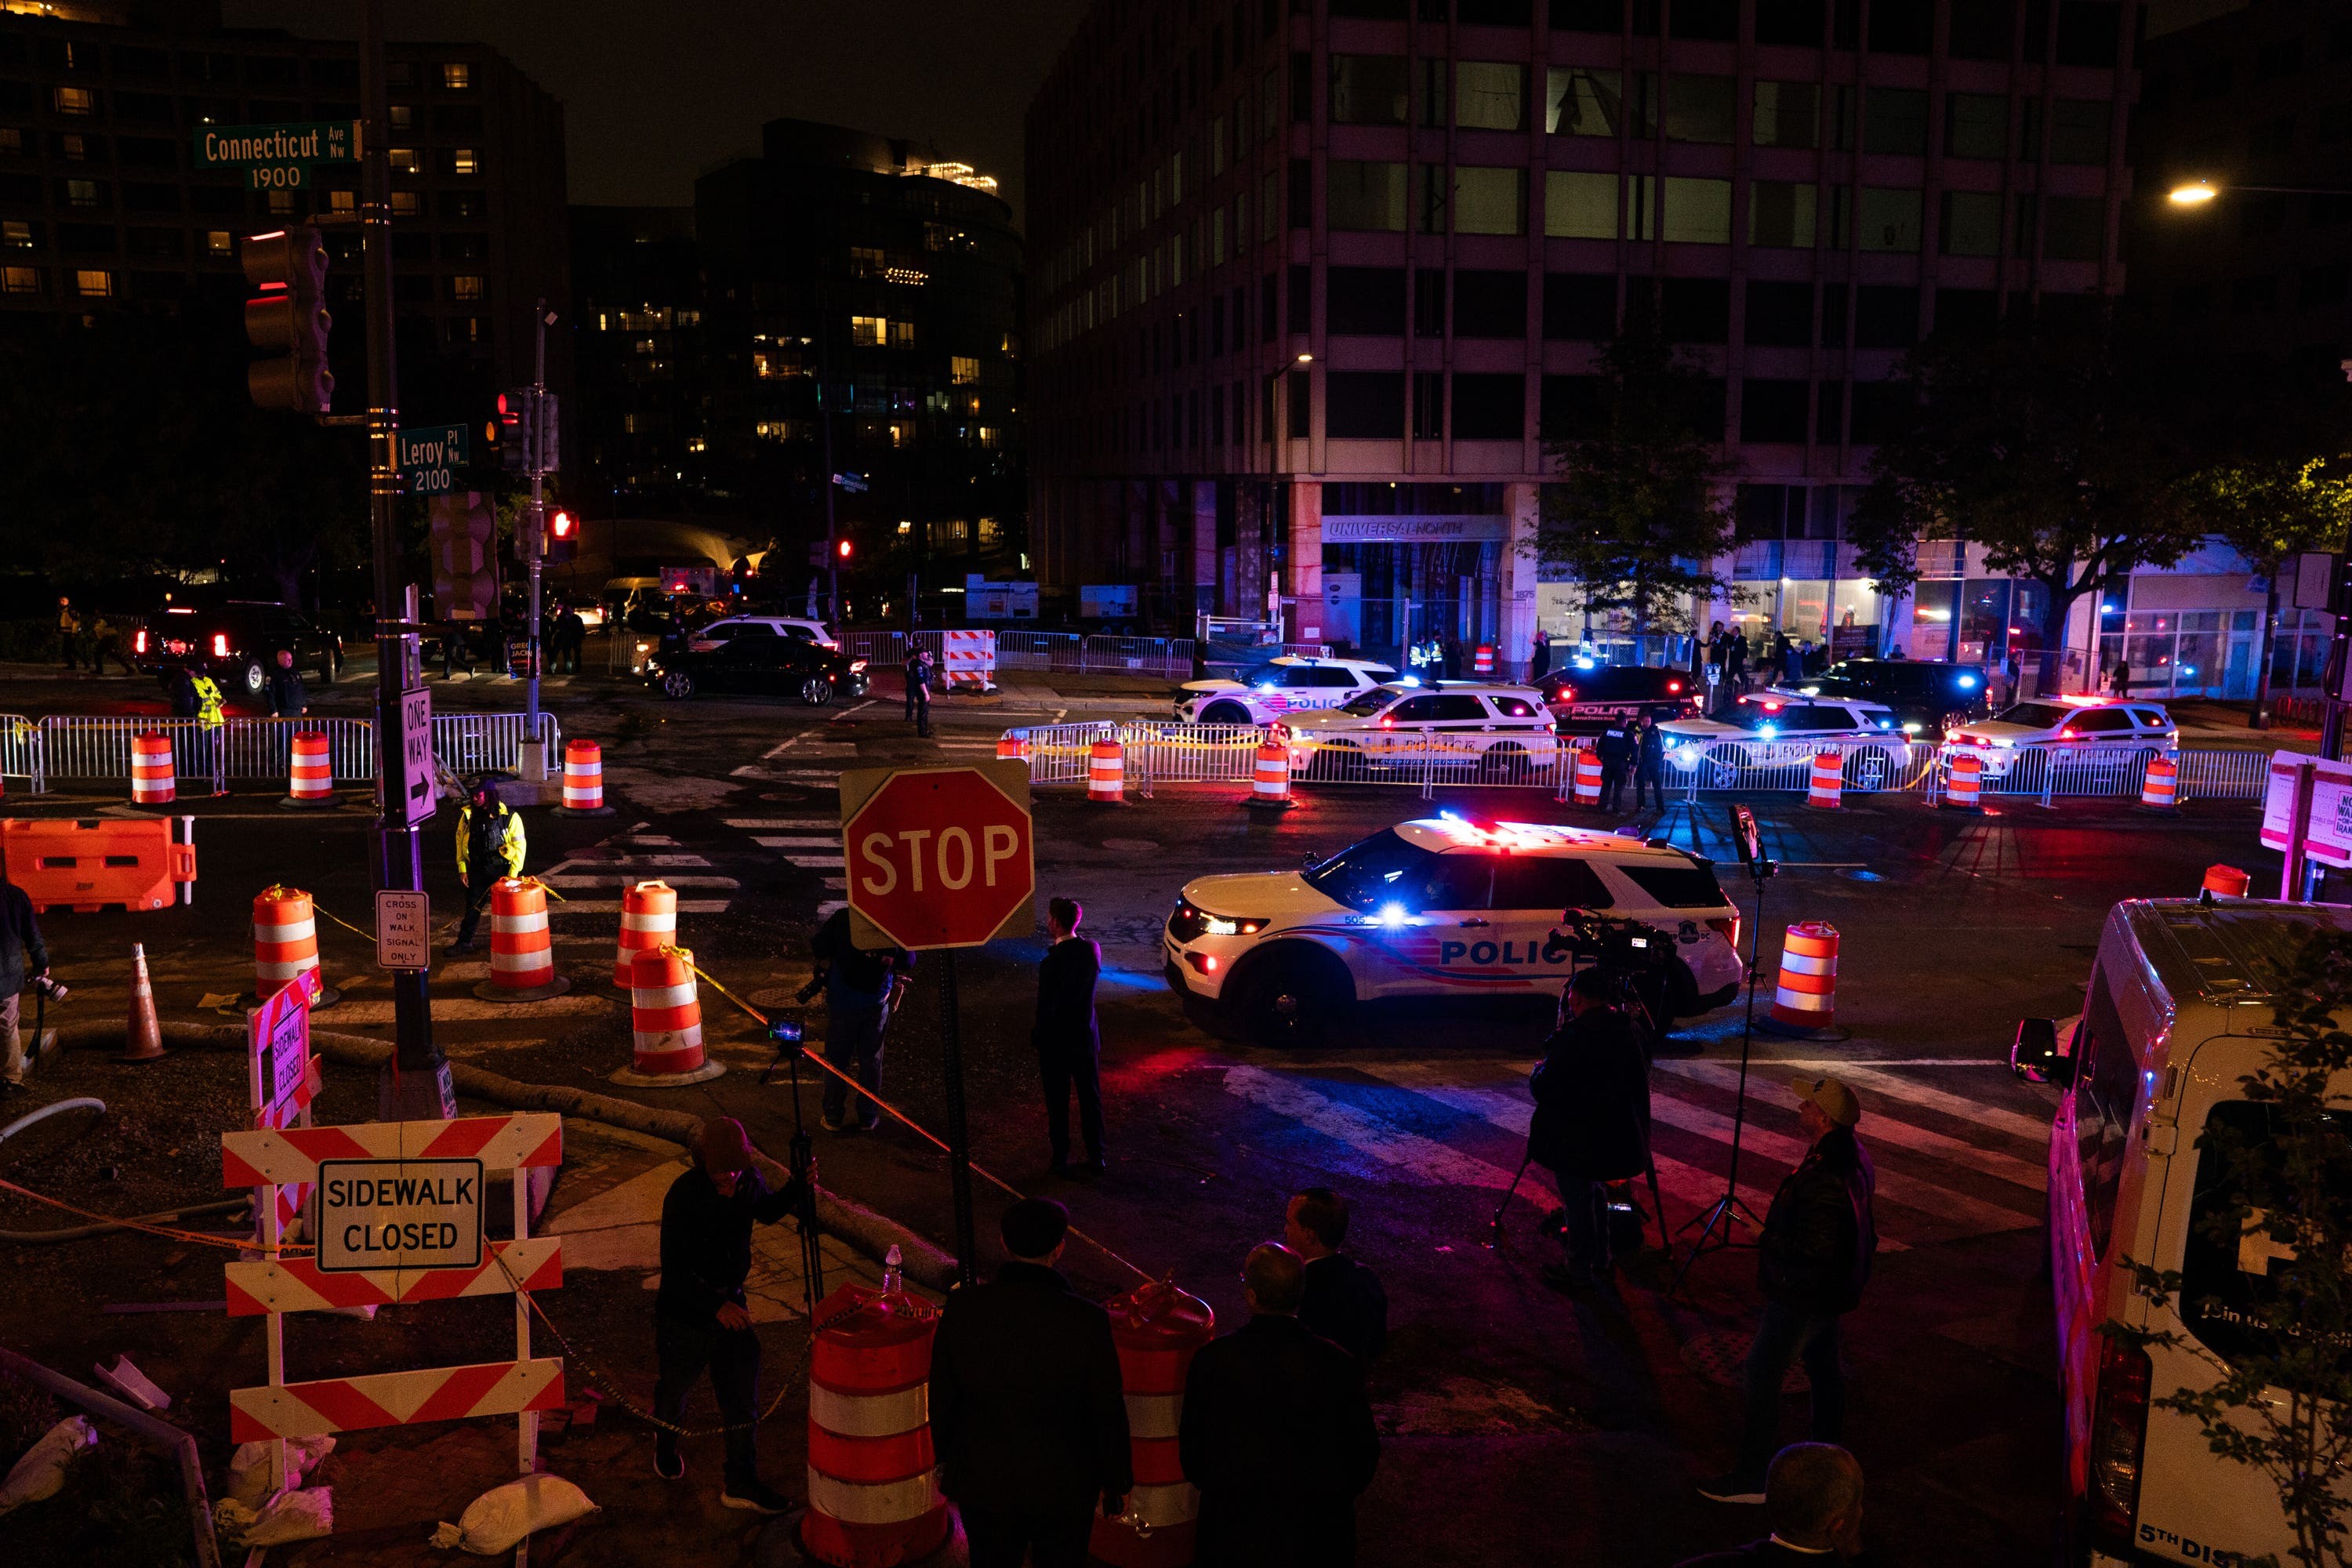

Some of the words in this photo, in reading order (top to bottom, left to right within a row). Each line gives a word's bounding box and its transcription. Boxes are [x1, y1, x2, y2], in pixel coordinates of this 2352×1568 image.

[205, 129, 319, 162] Connecticut
[328, 125, 344, 141] Ave
[329, 143, 345, 158] Nw
[252, 166, 301, 188] 1900
[401, 437, 445, 469] Leroy
[447, 429, 459, 445] Pl
[448, 447, 460, 463] Nw
[415, 469, 451, 492] 2100
[407, 699, 426, 731] ONE
[1287, 699, 1339, 710] POLIC
[408, 733, 428, 767] WAY
[2338, 804, 2352, 818] WA
[862, 824, 1019, 896] STOP
[386, 900, 417, 909] CROSS
[1345, 916, 1366, 924] 505
[390, 953, 416, 961] ONLY
[274, 1019, 303, 1062] SIDEWALK
[278, 1053, 301, 1091] CLOSED
[327, 1178, 474, 1207] SIDEWALK
[343, 1222, 458, 1252] CLOSED
[2245, 1315, 2270, 1330] us
[2140, 1523, 2179, 1544] 5TH
